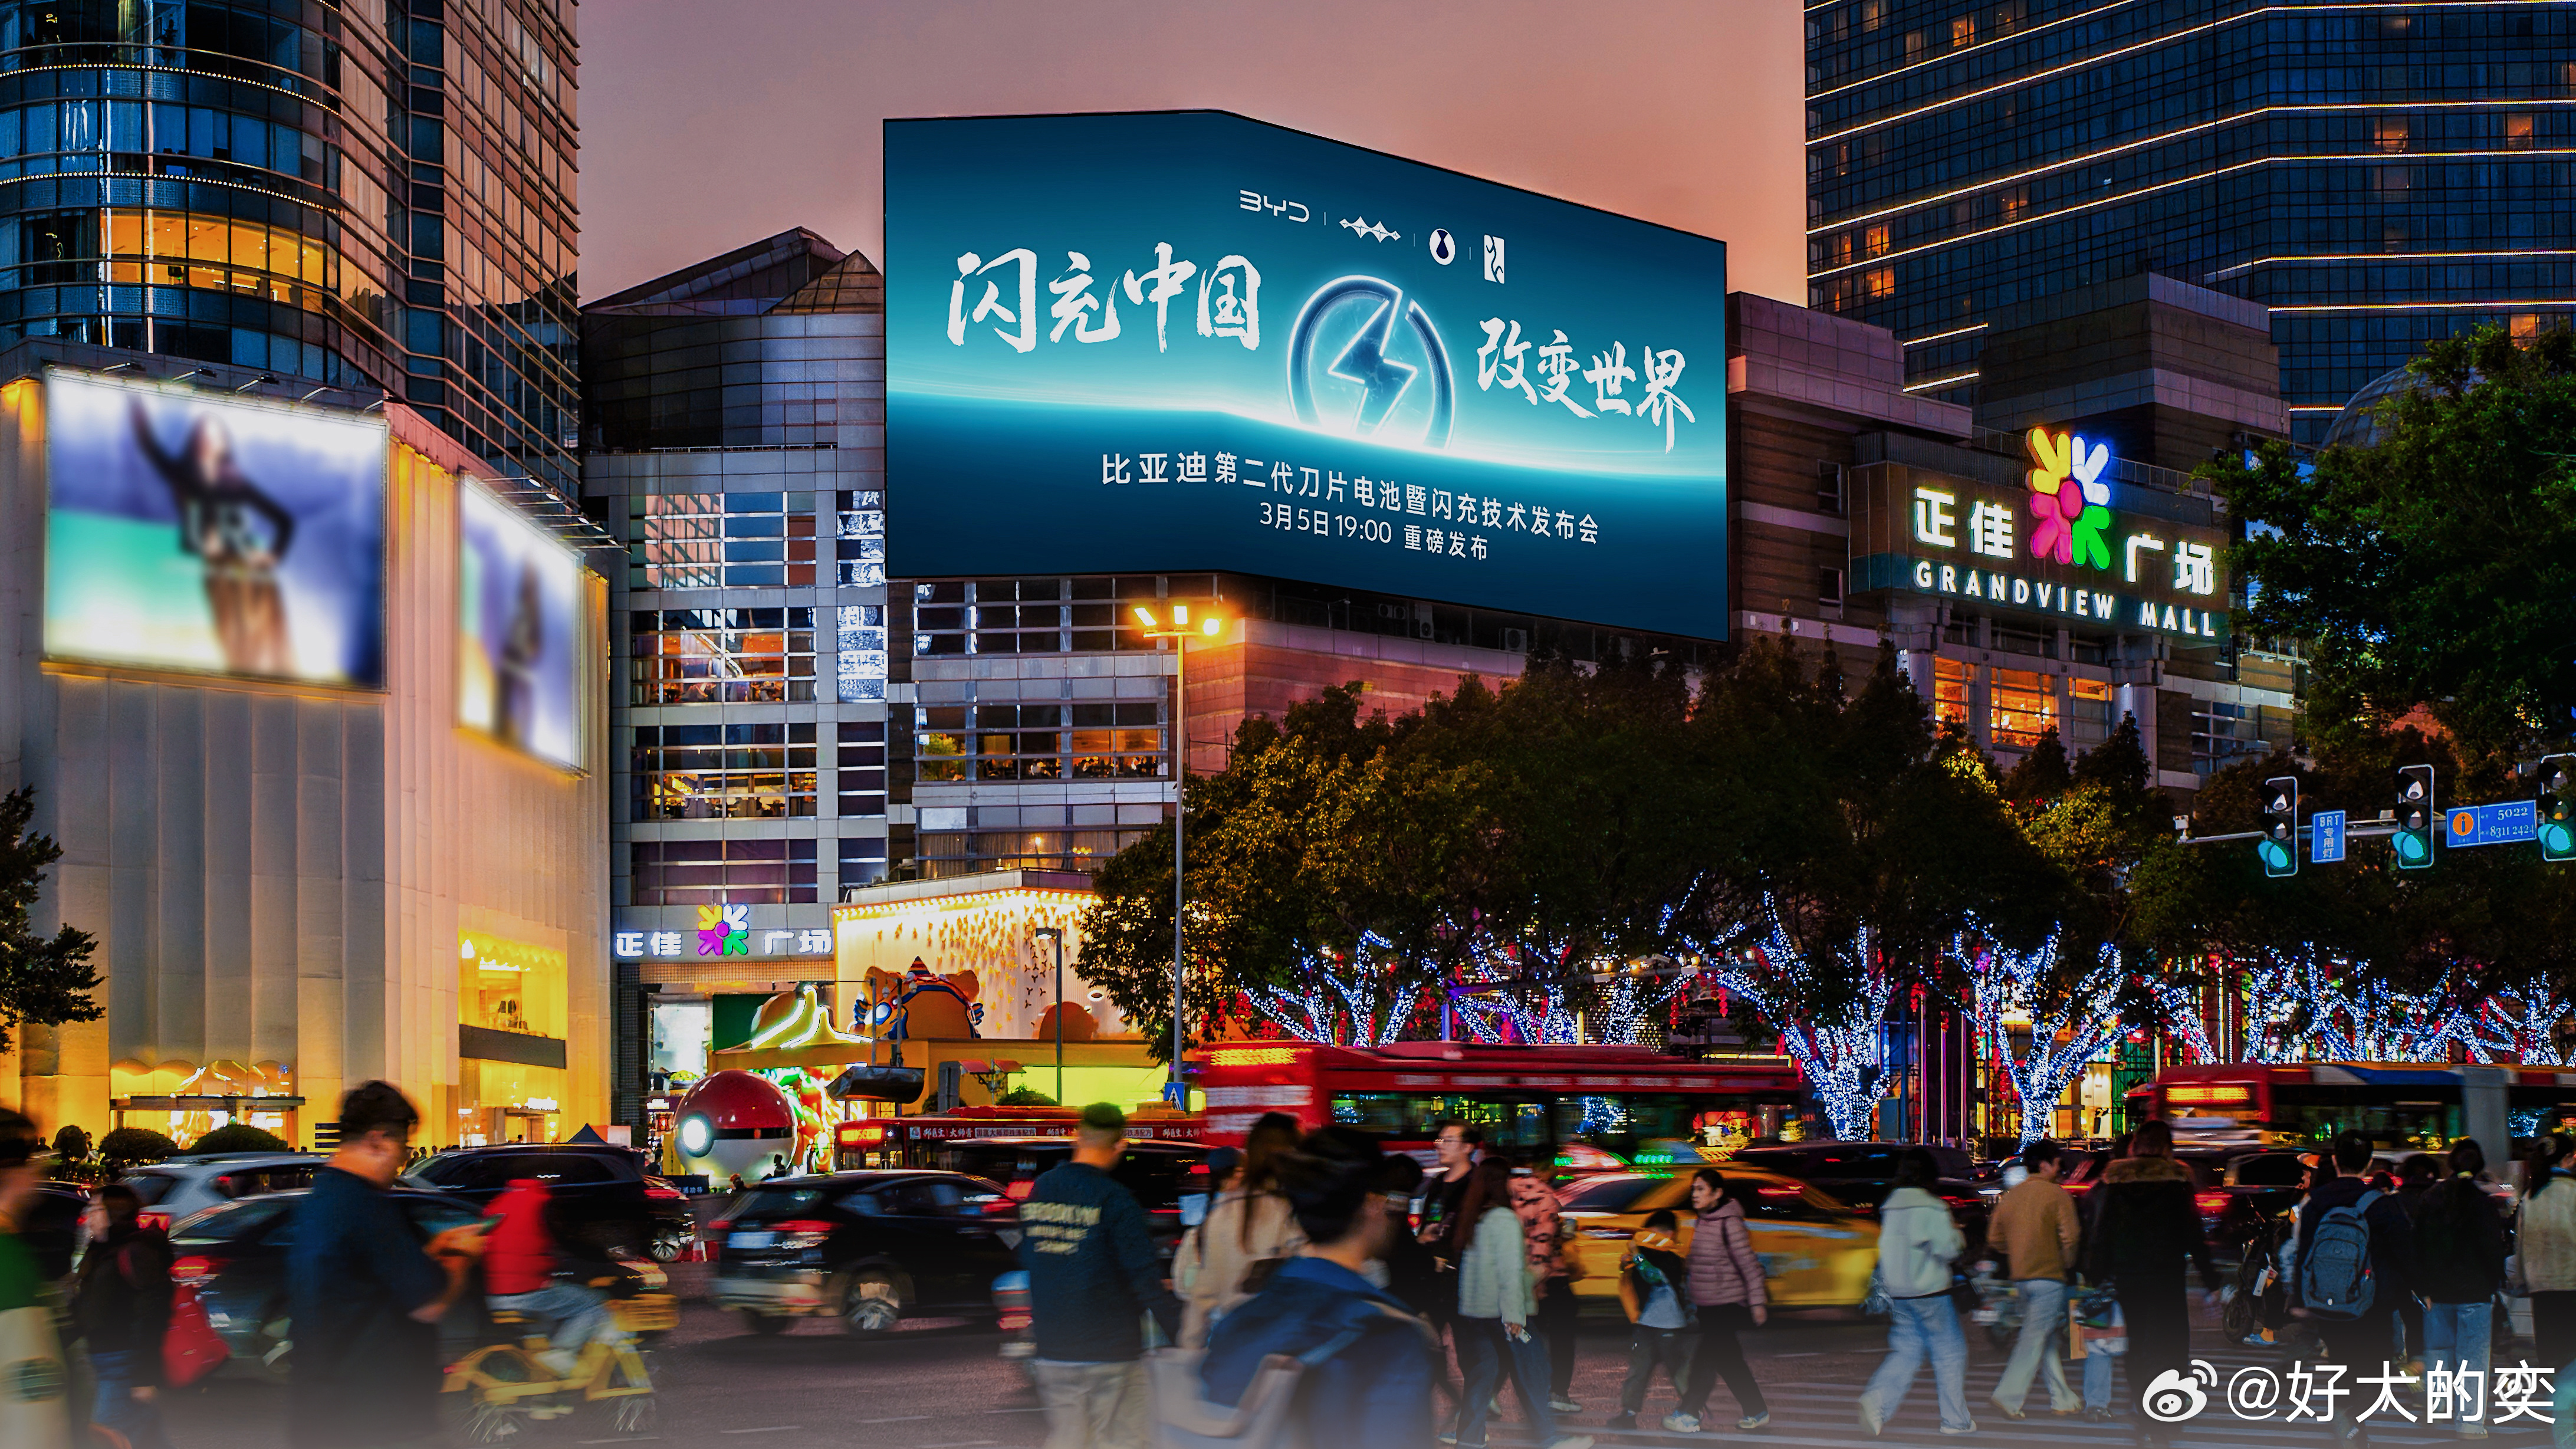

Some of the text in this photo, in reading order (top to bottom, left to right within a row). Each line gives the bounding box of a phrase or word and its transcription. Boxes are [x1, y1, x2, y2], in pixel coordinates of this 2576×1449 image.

[1240, 190, 1309, 222] BYD
[947, 242, 1696, 454] 闪充中国 改变世界
[1102, 452, 1599, 544] 比亚迪第二代刀片电池暨闪充技术发布会
[1259, 501, 1489, 561] 3月5日19:00 重磅发布
[1915, 487, 2214, 596] 正佳 广场
[1916, 561, 2215, 637] GRANDVIEW MALL
[2319, 815, 2340, 827] BRT
[2498, 807, 2528, 820] 5022
[616, 929, 832, 957] 正佳 广场
